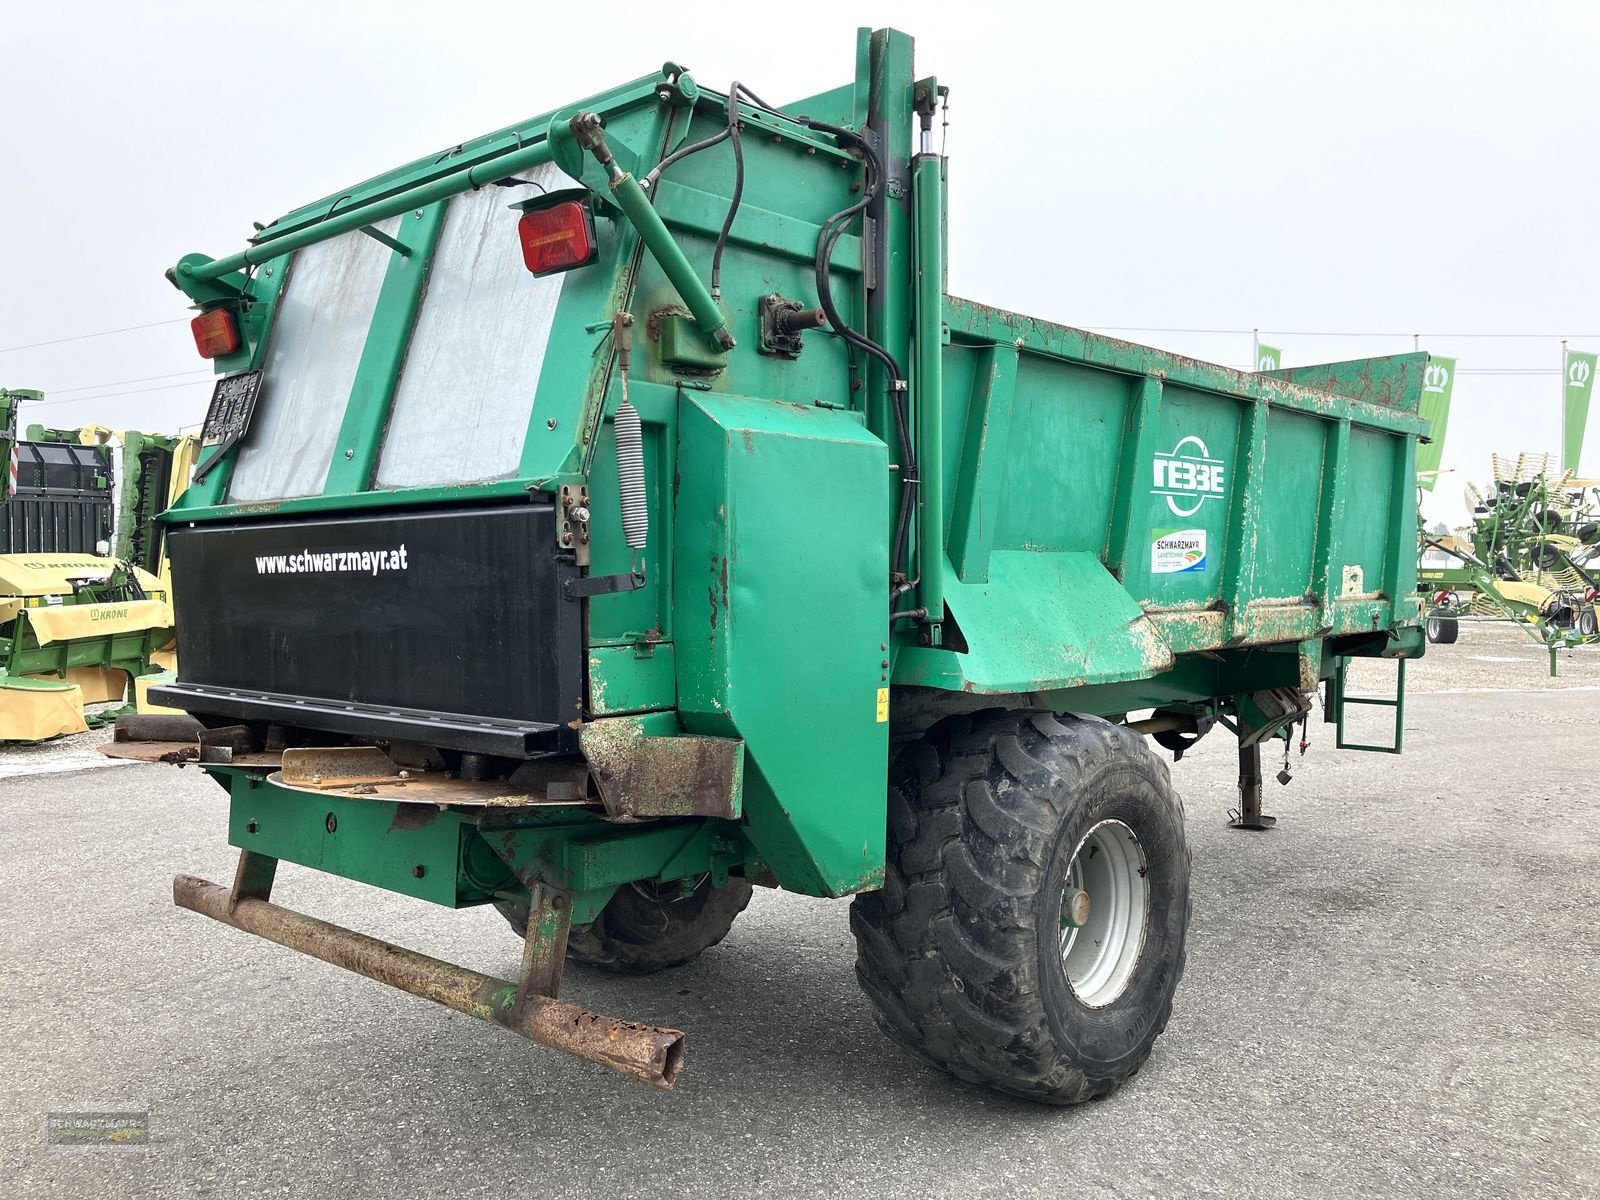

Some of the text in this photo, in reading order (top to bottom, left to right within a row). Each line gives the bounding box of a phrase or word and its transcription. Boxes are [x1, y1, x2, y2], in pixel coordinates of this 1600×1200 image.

[1157, 540, 1200, 550] SCHWARZMAYR
[255, 543, 408, 576] www.schwarzmayr.at
[100, 608, 128, 620] KRONE
